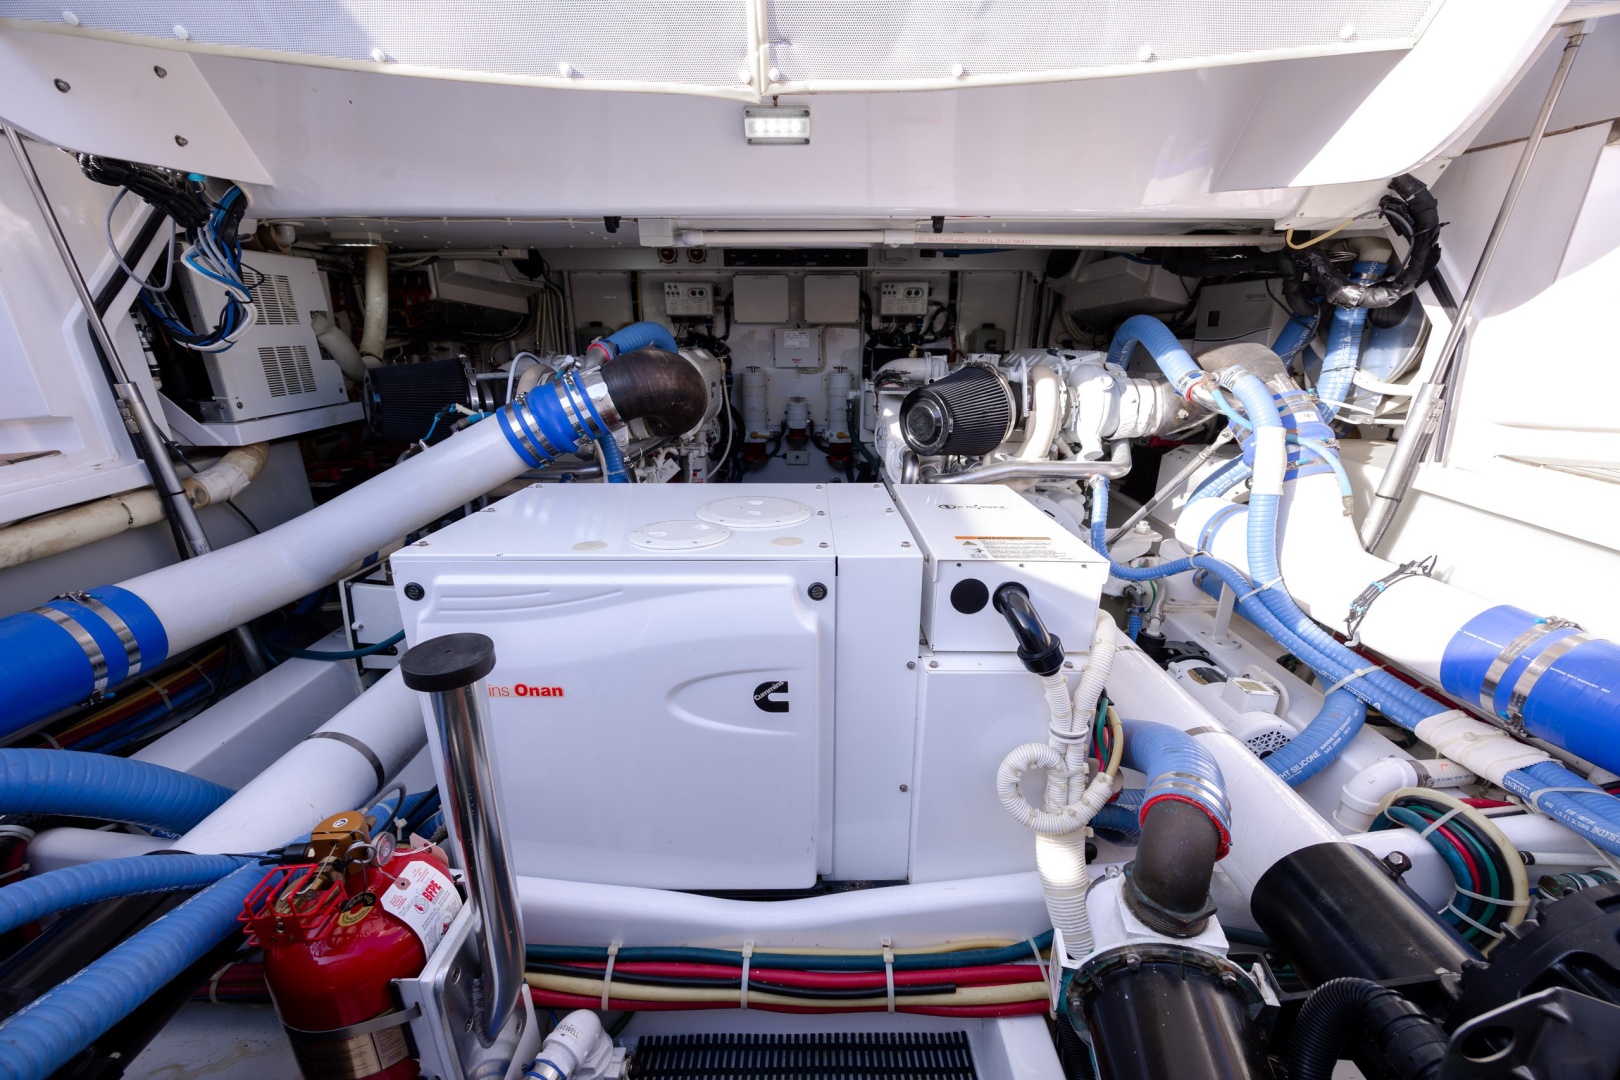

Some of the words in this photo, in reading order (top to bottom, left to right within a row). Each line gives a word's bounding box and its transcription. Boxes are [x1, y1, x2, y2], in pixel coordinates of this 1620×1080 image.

[514, 683, 563, 697] Onan
[754, 681, 785, 701] Cummins
[1320, 738, 1334, 750] MARINE
[1340, 716, 1353, 731] EXHAUST
[1290, 750, 1321, 773] SILICONE
[1504, 778, 1529, 798] TRIDENT
[421, 879, 442, 903] BFPE
